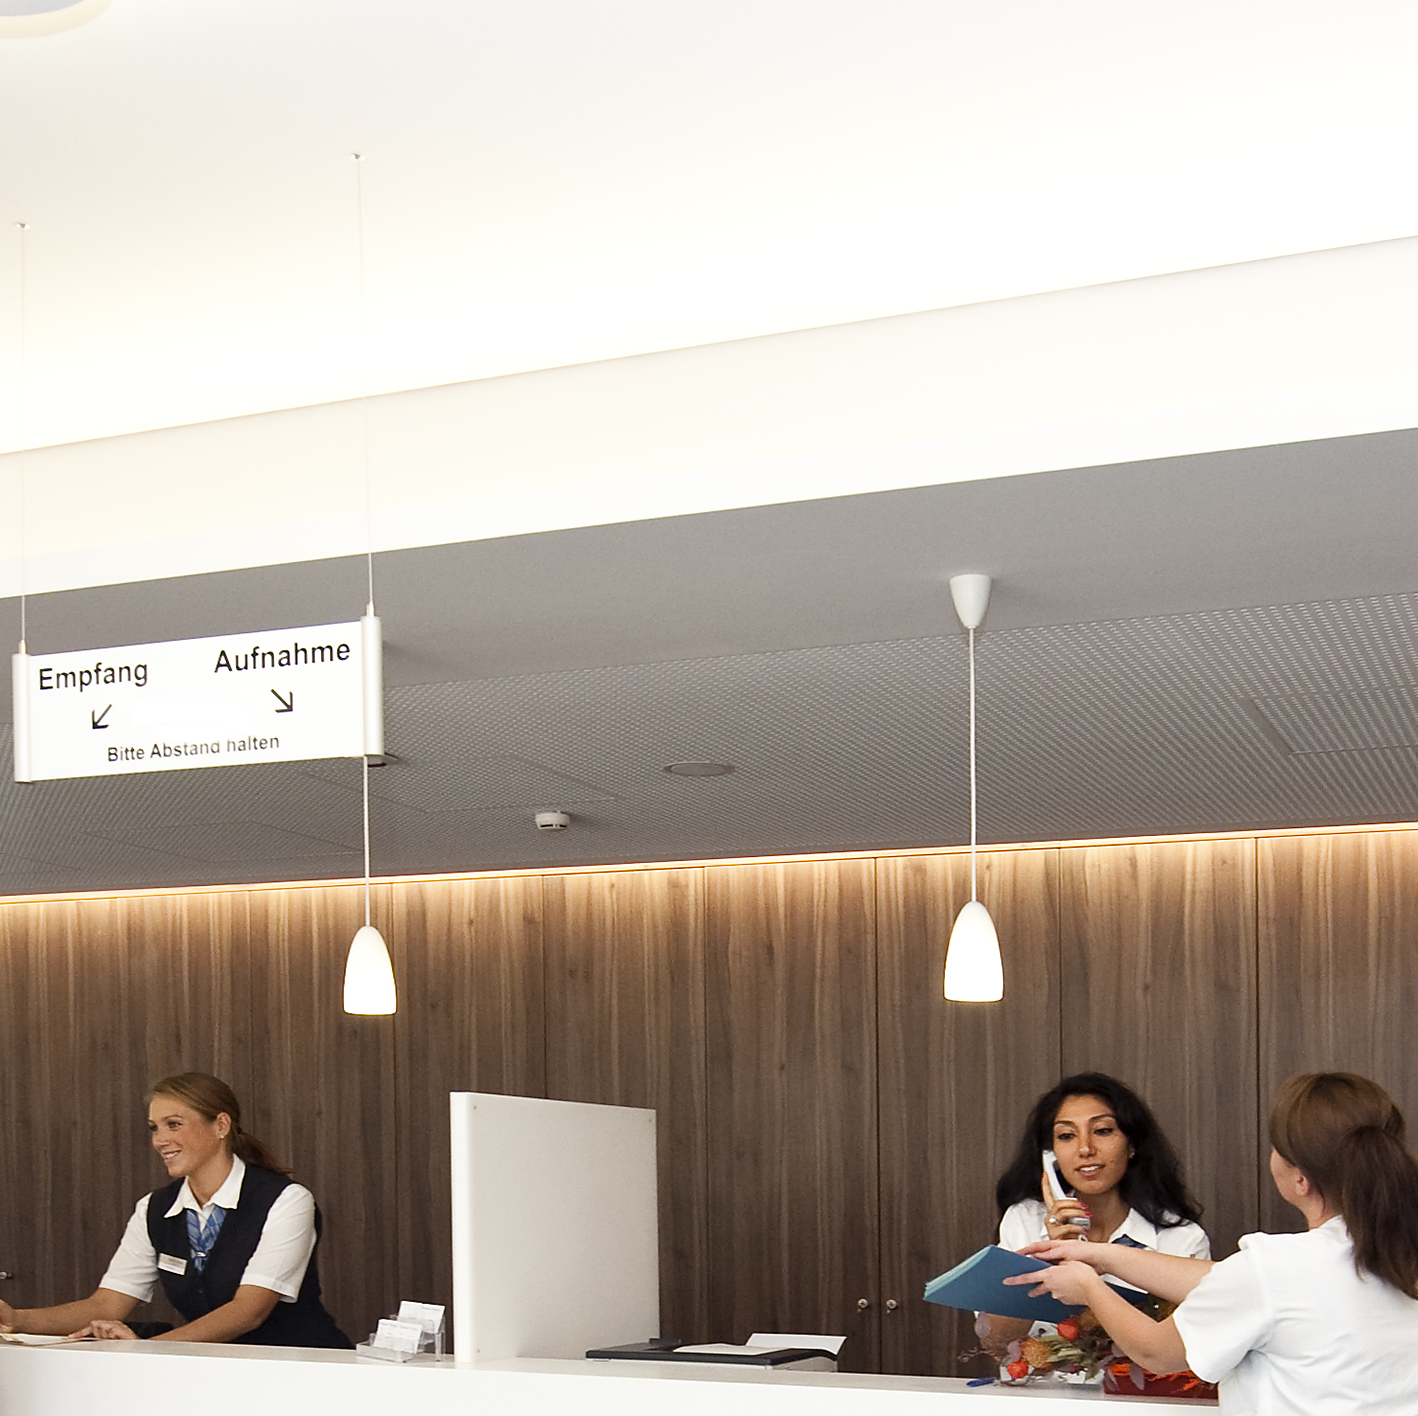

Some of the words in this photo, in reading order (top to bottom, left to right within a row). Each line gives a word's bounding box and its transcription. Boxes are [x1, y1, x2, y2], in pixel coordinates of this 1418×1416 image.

[38, 660, 149, 694] Empfang
[213, 641, 352, 675] Aufnahme
[107, 745, 146, 763] Bitte
[149, 740, 222, 760] Abstand
[227, 735, 280, 754] halten
